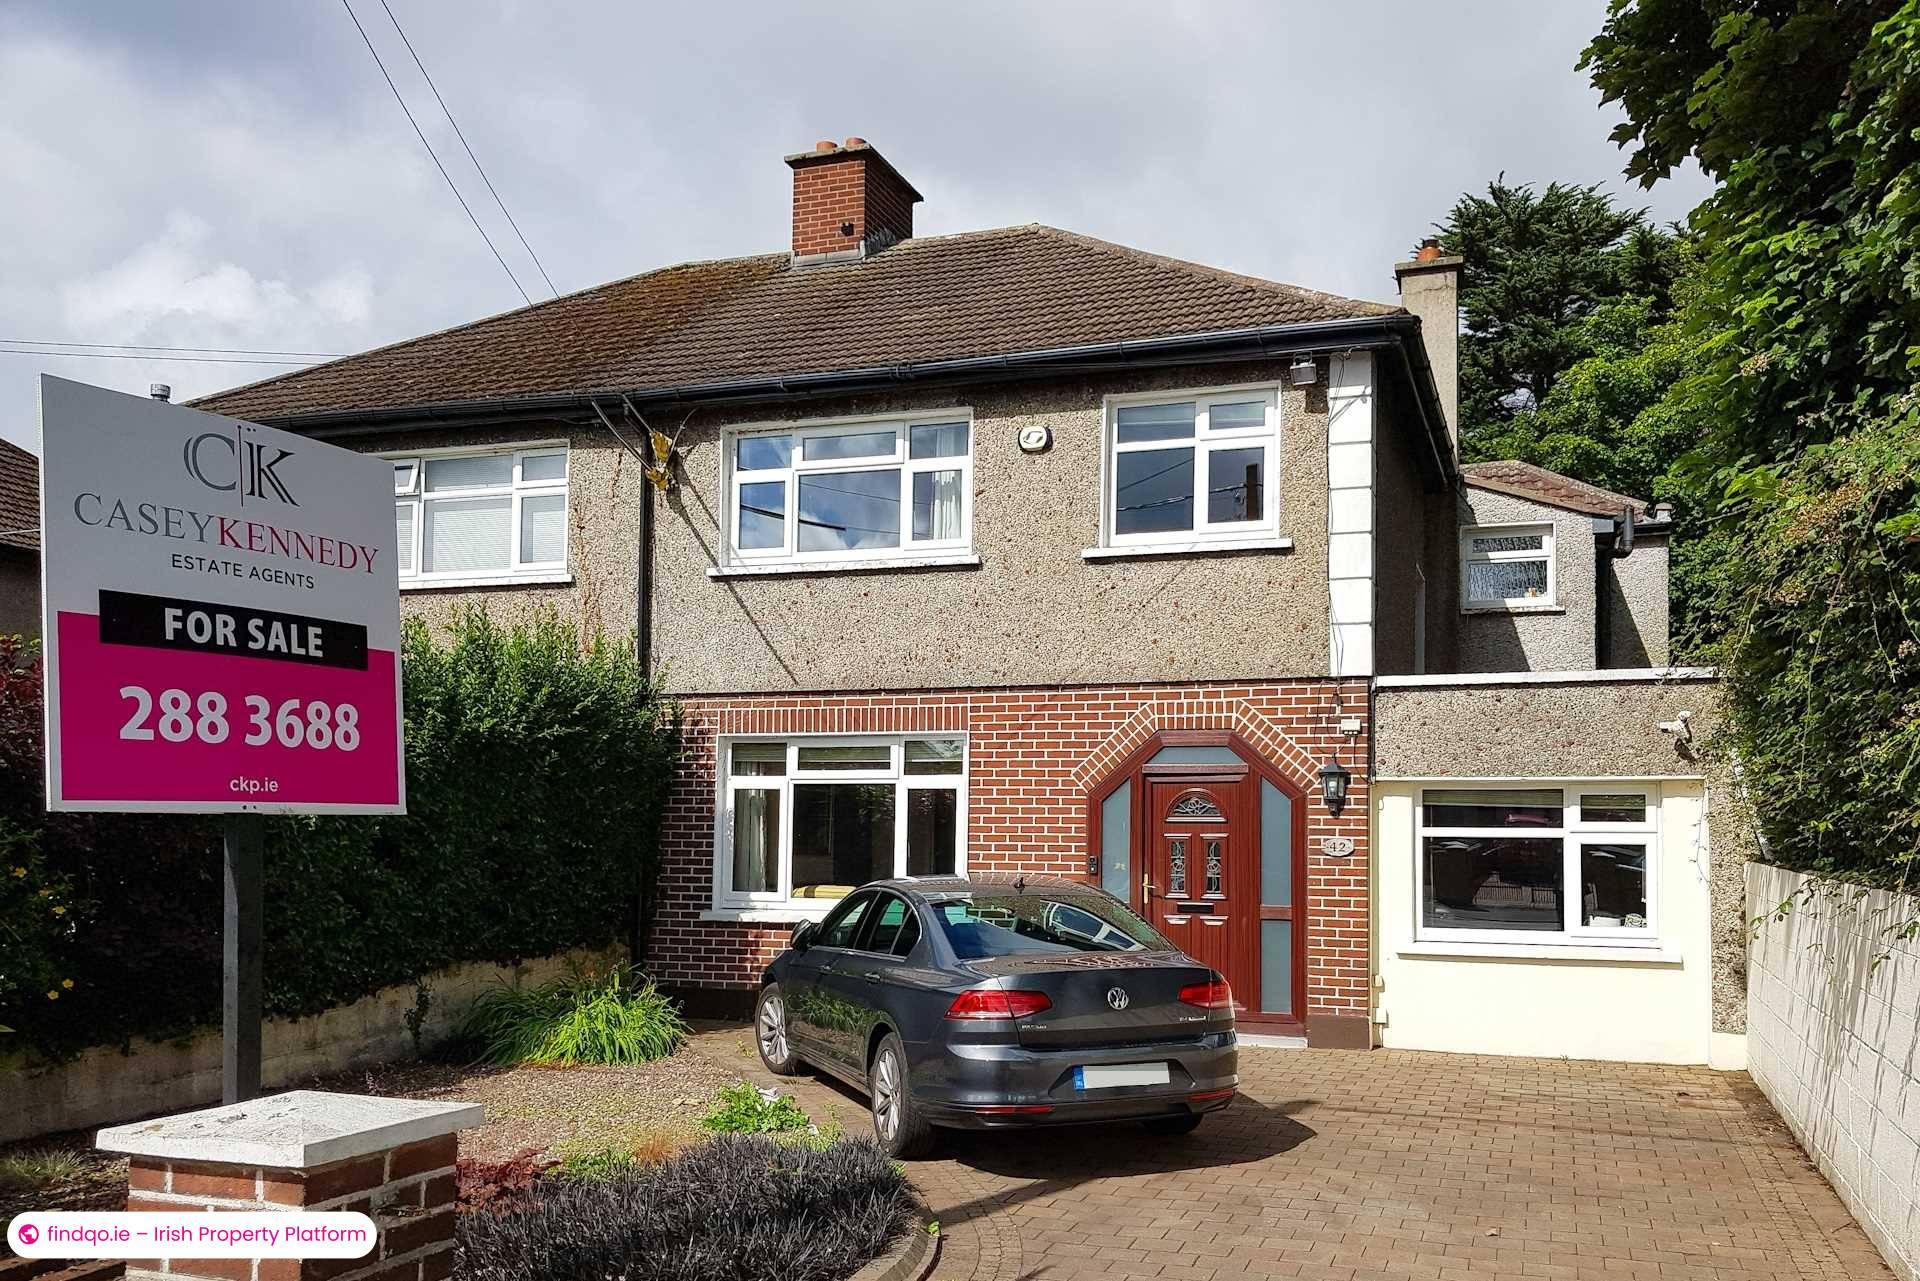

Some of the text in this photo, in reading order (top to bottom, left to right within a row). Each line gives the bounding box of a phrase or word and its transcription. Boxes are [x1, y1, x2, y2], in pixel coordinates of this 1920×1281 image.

[172, 554, 315, 590] ESTATE AGENTS
[164, 607, 324, 657] FOR SALE
[119, 686, 361, 751] 288 3688
[229, 776, 279, 794] ckp.ie
[1329, 842, 1346, 852] 42
